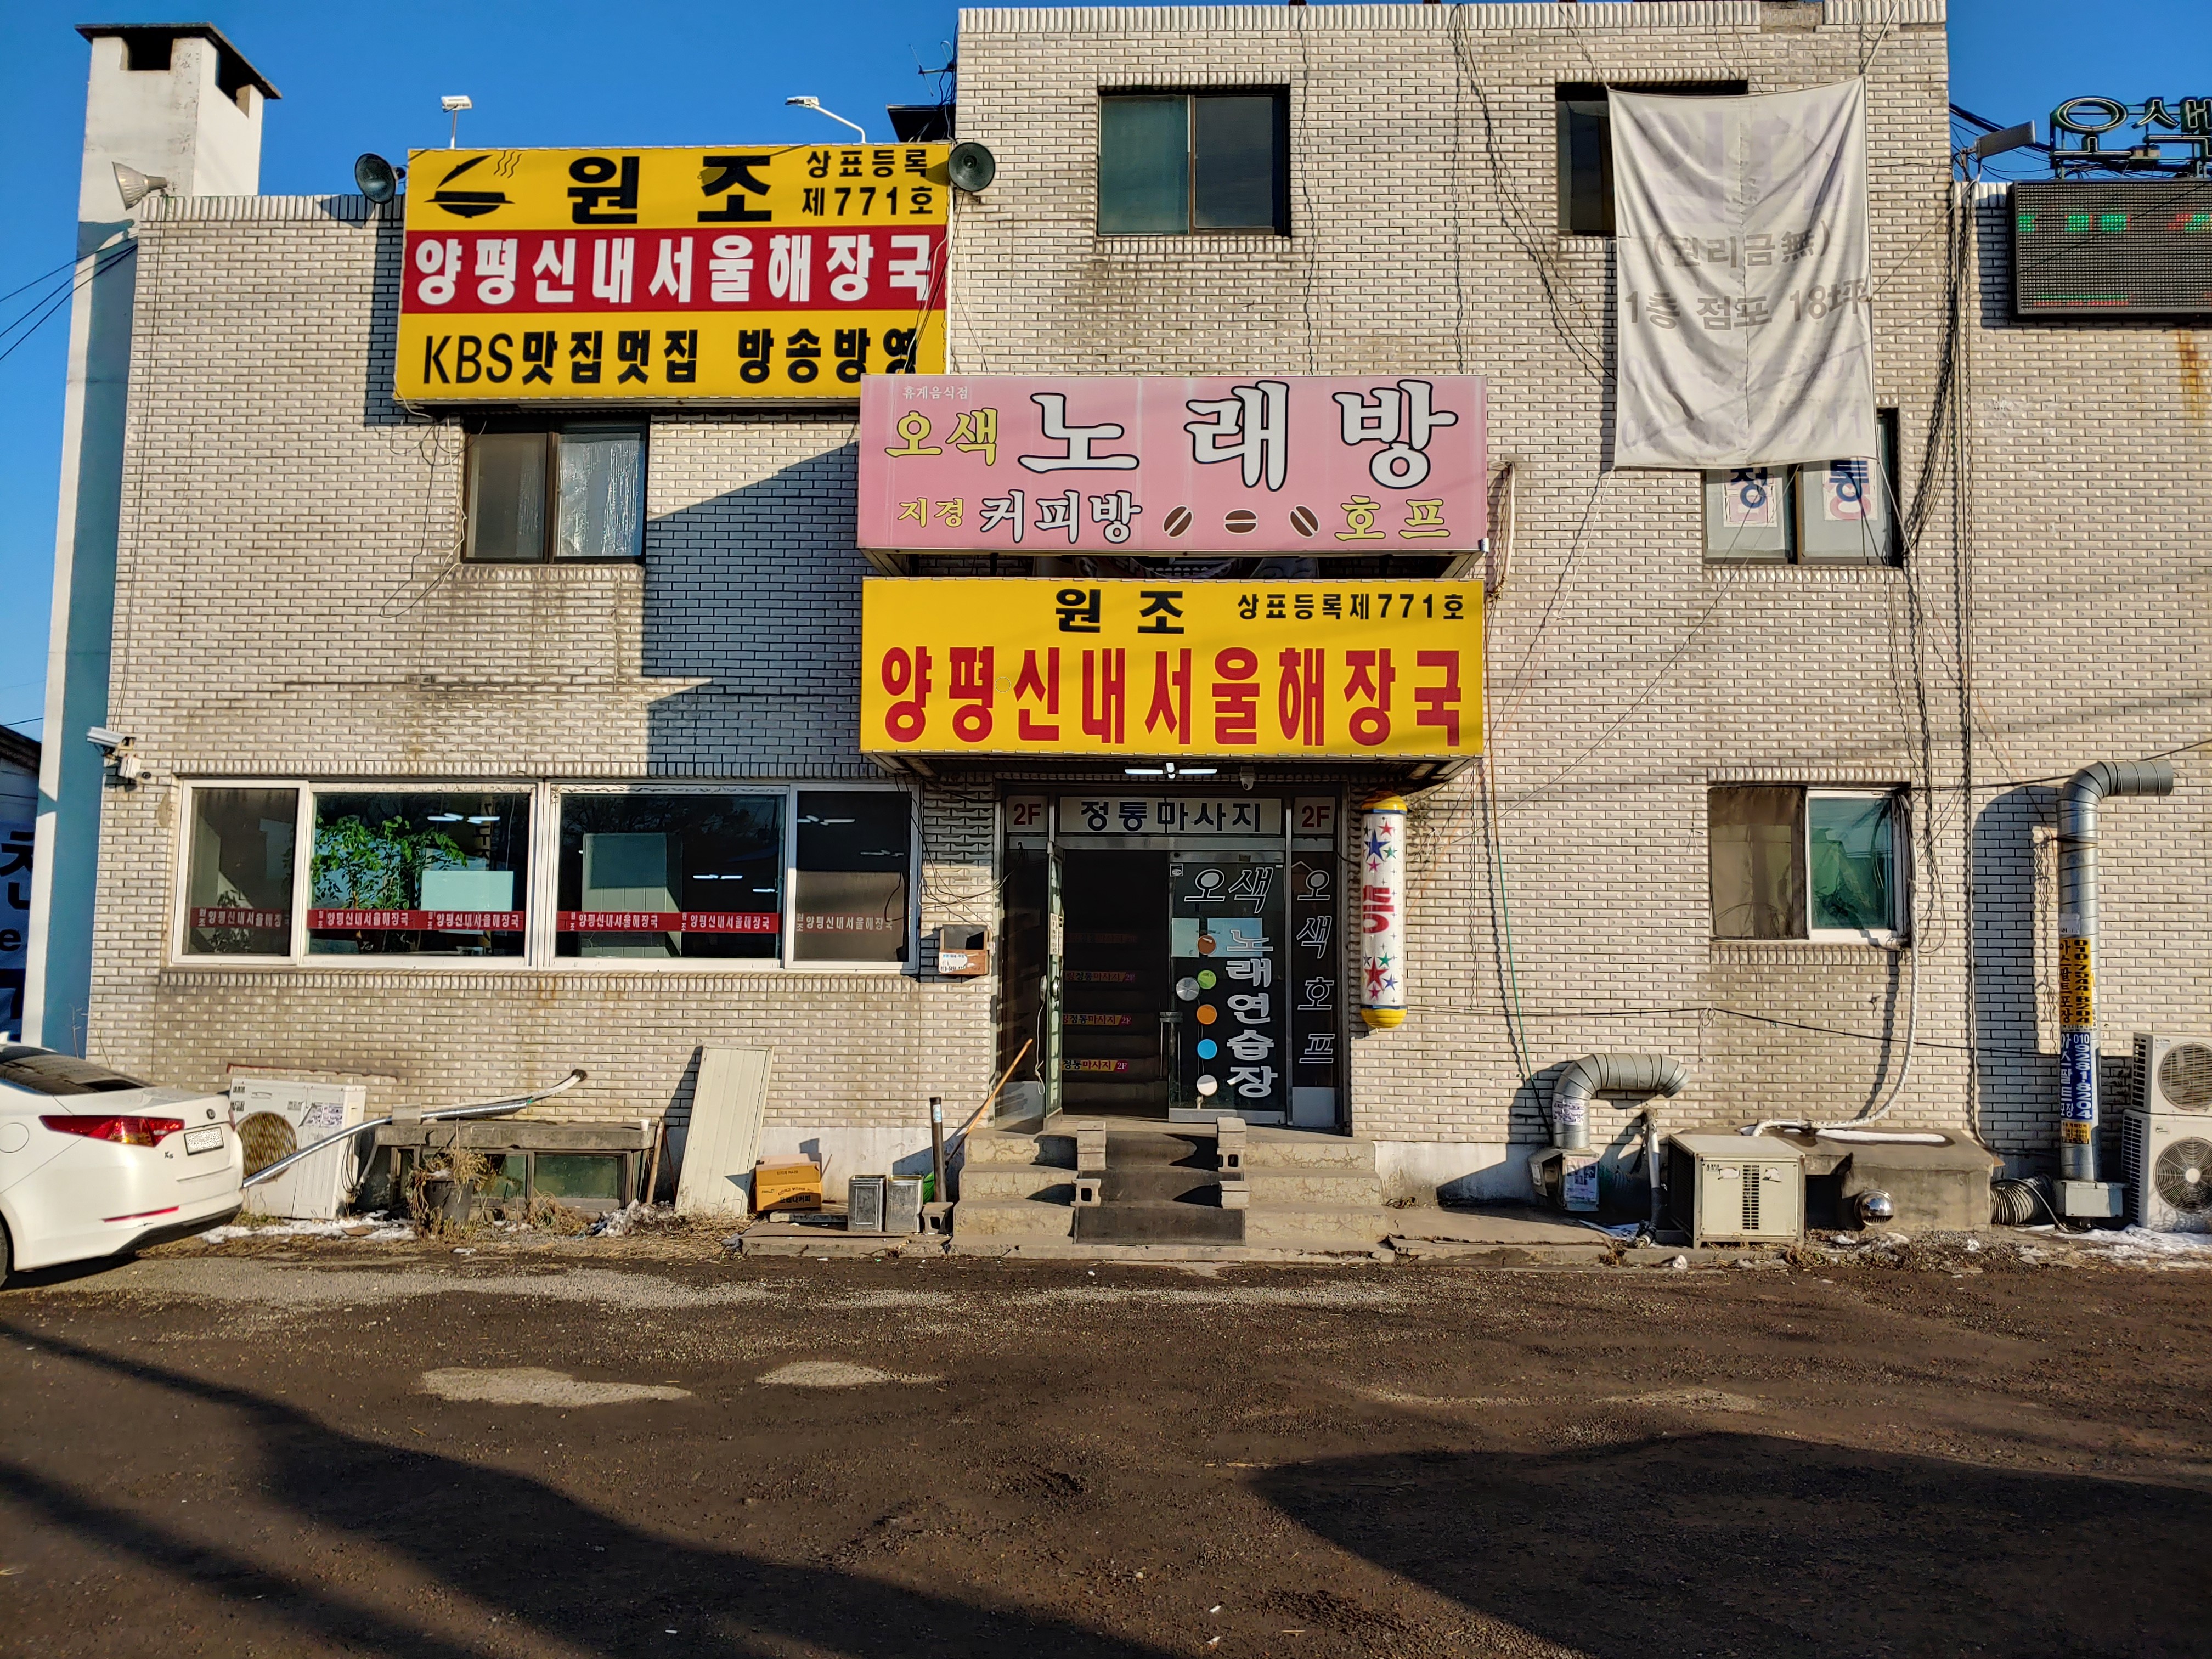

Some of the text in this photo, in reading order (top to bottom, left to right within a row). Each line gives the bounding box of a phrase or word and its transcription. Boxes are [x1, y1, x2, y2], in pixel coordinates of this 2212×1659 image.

[806, 149, 927, 179] 상표등록
[802, 186, 933, 216] 제771호
[415, 235, 931, 306] 양평신내서울해장국
[1624, 291, 1681, 330] 1층
[1696, 296, 1773, 330] 점포
[738, 327, 917, 384] 방송방영
[902, 386, 968, 400] 휴게음식점
[885, 380, 1458, 491] 오색 노래방
[898, 489, 1451, 544] 지경 커피방 호프
[881, 646, 1462, 747] 양평신내서울해장국
[1013, 803, 1041, 826] 2F
[1081, 800, 1261, 832] 정통마사지
[1301, 805, 1330, 828] 2F
[1183, 867, 1274, 914] 오색
[1297, 869, 1335, 1064] 오색호프
[1226, 929, 1278, 1098] 노래연습장
[2073, 1034, 2090, 1044] 010
[1117, 1062, 1127, 1070] 2F
